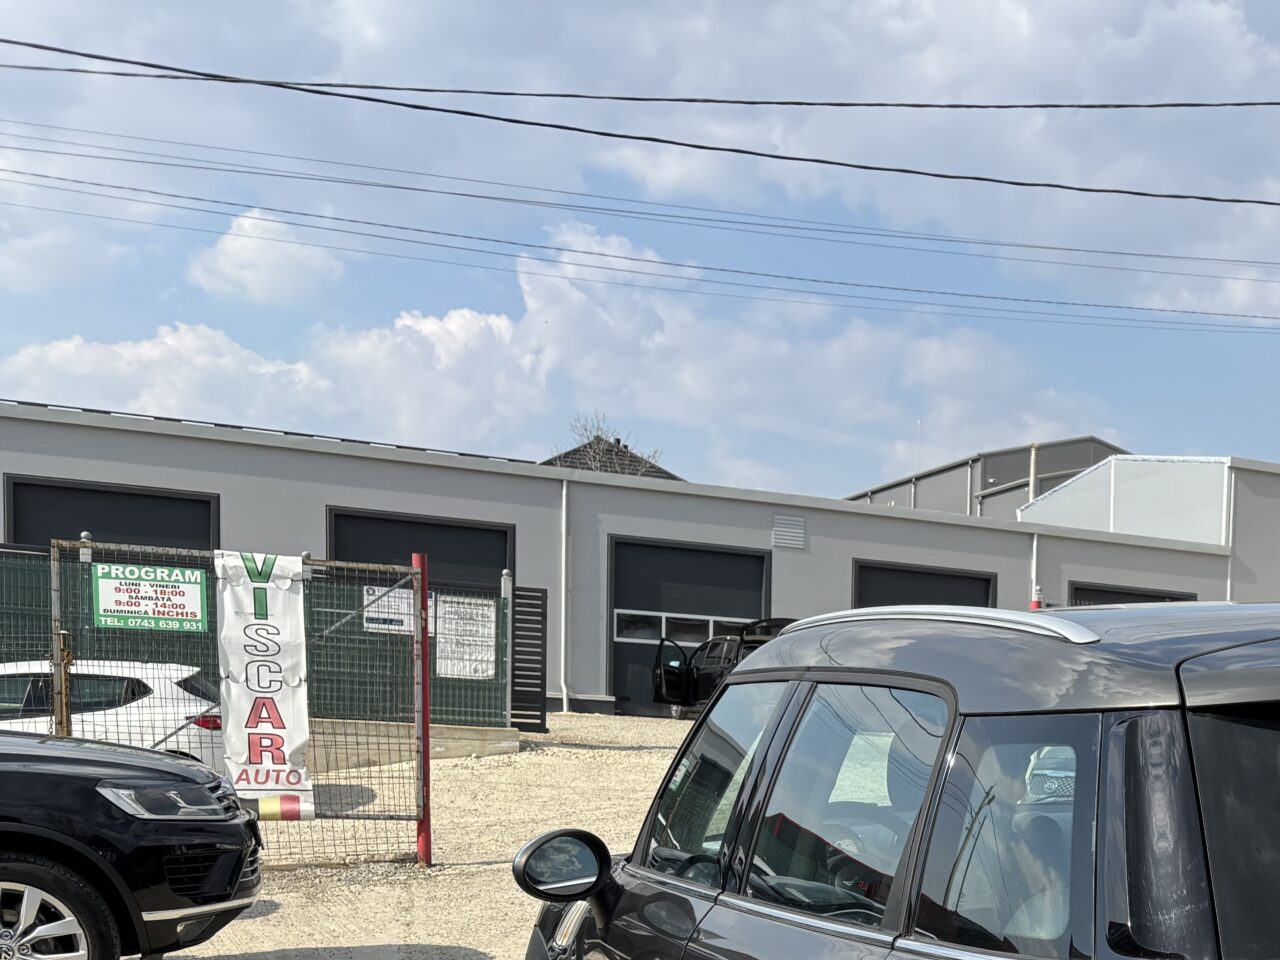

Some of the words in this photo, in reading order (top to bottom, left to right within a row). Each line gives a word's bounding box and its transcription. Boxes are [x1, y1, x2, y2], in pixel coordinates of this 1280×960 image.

[97, 564, 201, 583] PROGRAM
[152, 589, 186, 597] 18:00
[153, 602, 186, 610] 14:00
[152, 608, 198, 619] ÎNCHIS
[100, 617, 124, 626] TEL:
[128, 619, 155, 628] 0743
[159, 620, 179, 629] 639
[183, 621, 202, 630] 931
[240, 552, 287, 765] VISCAR
[234, 768, 302, 786] AUTO
